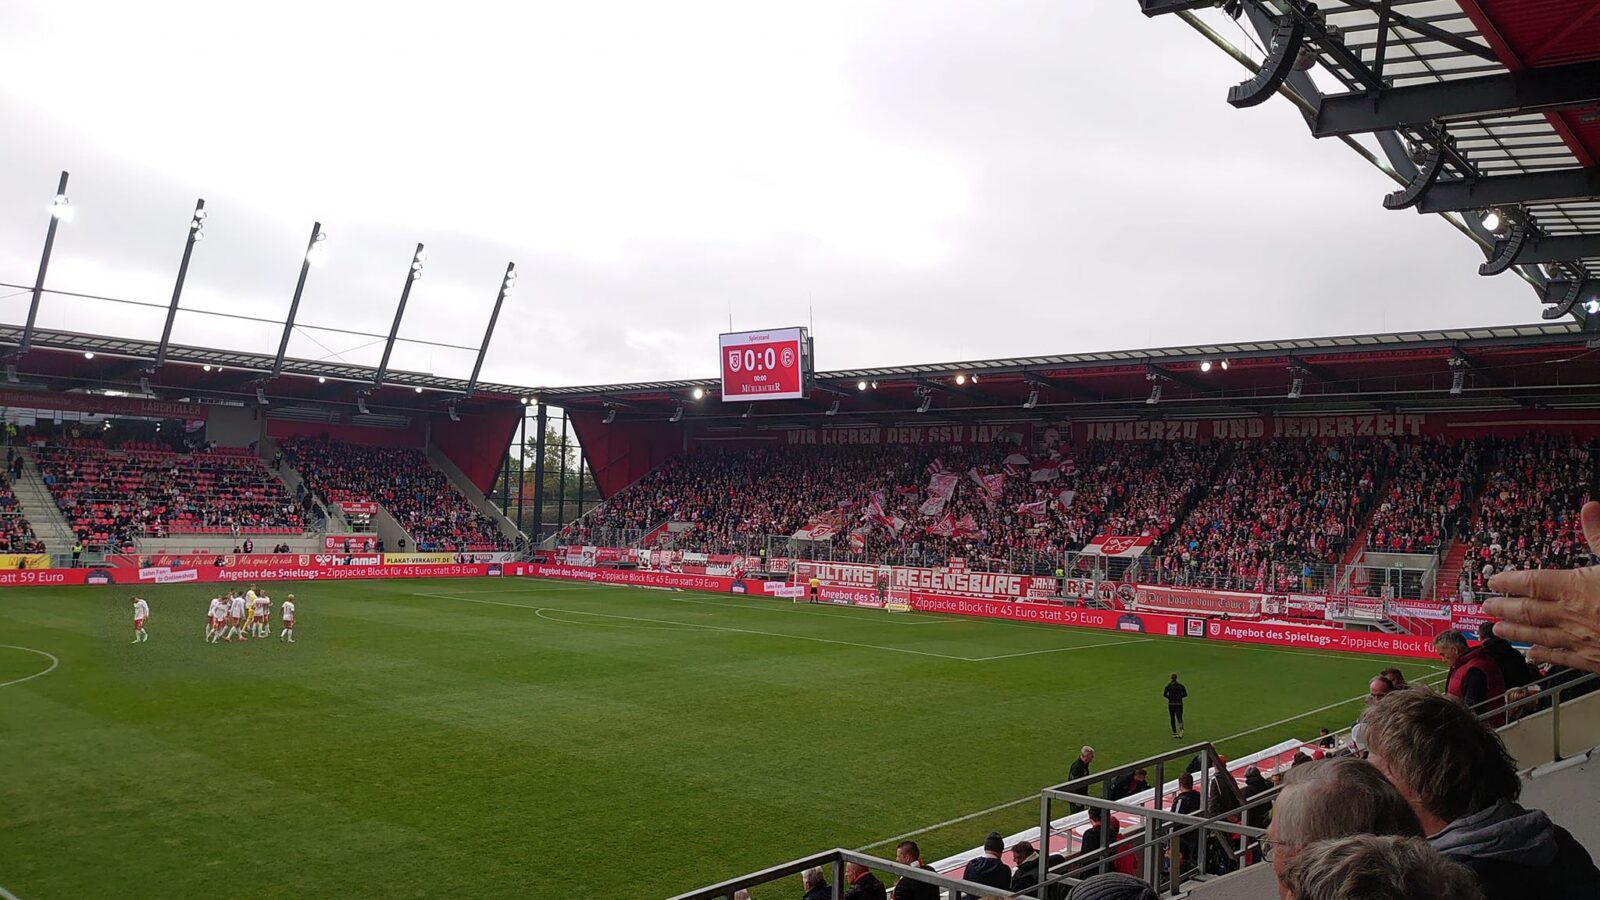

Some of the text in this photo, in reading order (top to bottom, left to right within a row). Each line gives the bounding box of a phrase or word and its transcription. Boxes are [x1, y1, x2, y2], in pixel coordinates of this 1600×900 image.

[744, 347, 776, 372] 0:0
[787, 429, 817, 445] WIR
[928, 425, 963, 443] SSV
[1087, 413, 1426, 441] IMMERZU UND JEDERZEIT
[218, 569, 259, 580] Angebot
[261, 569, 276, 578] des
[278, 568, 319, 580] Spieltags
[326, 567, 366, 580] Zippjacke
[367, 566, 388, 576] Block
[390, 566, 401, 576] für
[403, 566, 413, 576] 45
[415, 566, 431, 575] Euro
[433, 566, 449, 575] statt
[451, 566, 461, 575] 59
[462, 566, 478, 575] Euro
[683, 558, 722, 569] REGENSBURG
[19, 572, 35, 583] 59
[38, 572, 64, 583] Euro
[538, 567, 560, 577] Angebot
[572, 569, 597, 581] Spieltags
[602, 571, 628, 584] Zippjacke
[629, 572, 645, 583] Block
[646, 573, 655, 584] für
[656, 574, 664, 584] 45
[665, 575, 678, 586] Euro
[679, 576, 693, 587] statt
[695, 577, 704, 587] 59
[705, 578, 719, 588] Euro
[816, 565, 874, 583] ULTRAS
[896, 569, 1021, 596] REGENSBURG
[1030, 577, 1056, 590] JAHN
[820, 588, 854, 600] Angebot
[854, 590, 868, 601] des
[915, 597, 955, 612] Zippjacke
[959, 601, 983, 613] Block
[985, 602, 998, 614] für
[1000, 604, 1013, 616] 45
[1016, 606, 1037, 619] Euro
[1040, 608, 1061, 620] statt
[1064, 611, 1077, 621] 59
[1080, 612, 1104, 624] Euro
[1453, 604, 1467, 613] SSV
[1451, 622, 1480, 630] Beratzha
[1223, 626, 1264, 640] Angebot
[1266, 630, 1283, 640] des
[1285, 631, 1331, 645] Spieltags
[1341, 636, 1389, 649] Zippjacke
[1392, 639, 1421, 652] Block
